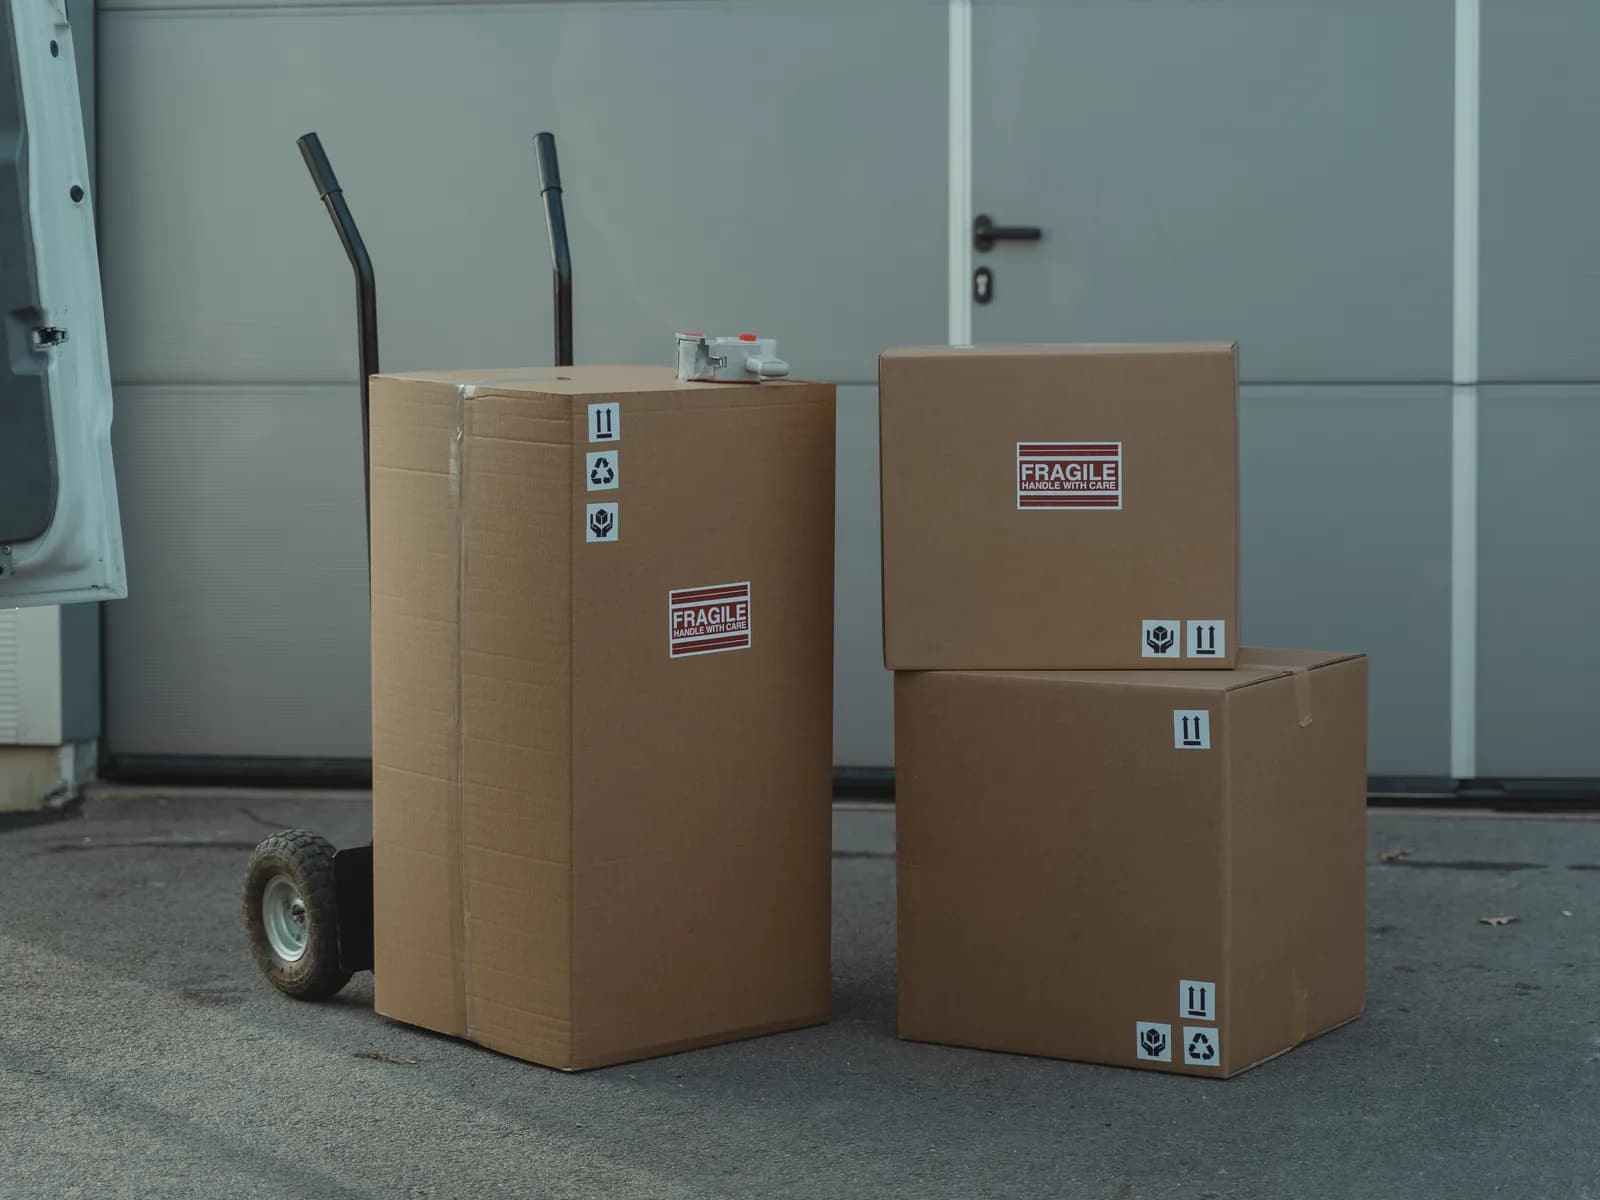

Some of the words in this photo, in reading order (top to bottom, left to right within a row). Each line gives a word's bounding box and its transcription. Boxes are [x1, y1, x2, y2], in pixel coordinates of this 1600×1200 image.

[1021, 463, 1116, 481] FRAGILE
[1022, 481, 1060, 490] HANDLE
[1063, 481, 1087, 490] WITH
[1089, 481, 1116, 490] CARE
[673, 604, 746, 629] FRAGILE
[673, 626, 704, 638] HANDLE
[706, 624, 724, 633] WITH
[726, 621, 746, 631] CARE
